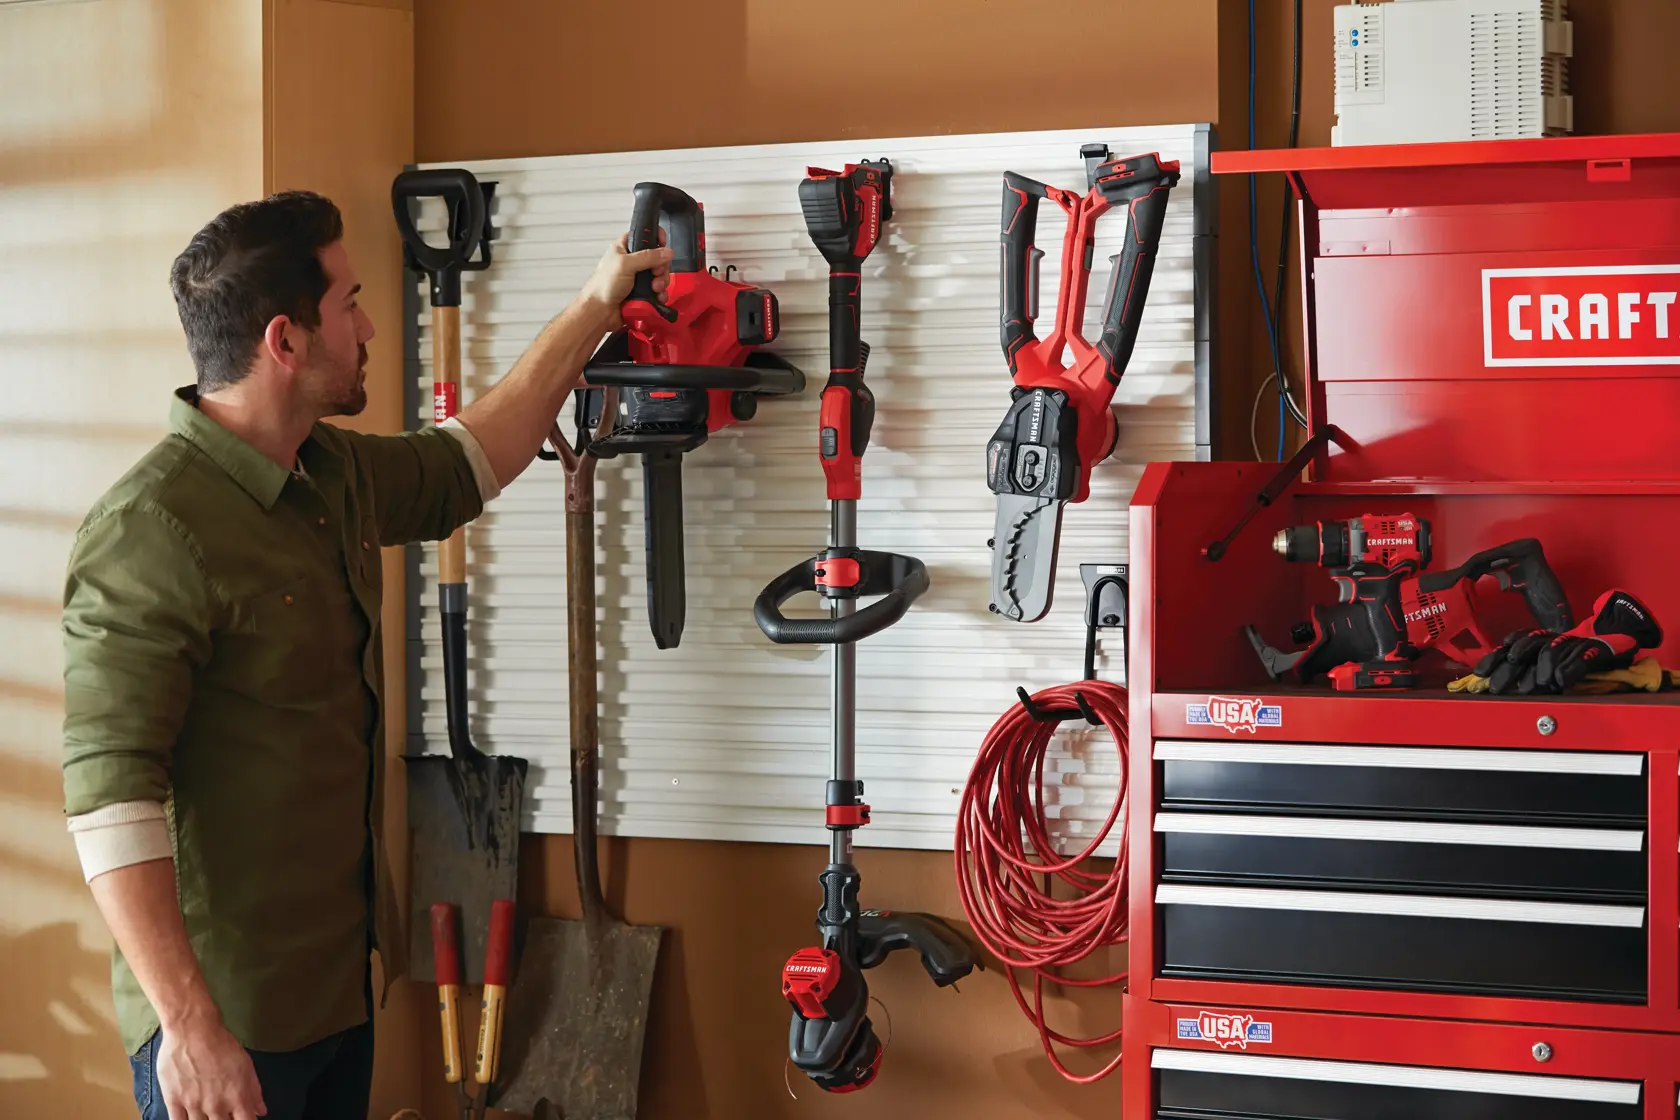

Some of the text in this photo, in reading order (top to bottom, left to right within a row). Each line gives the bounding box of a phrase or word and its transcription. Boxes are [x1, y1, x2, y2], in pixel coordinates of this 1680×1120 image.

[869, 195, 877, 244] CRAFTSMAN
[1508, 292, 1678, 341] CRAFT
[1029, 390, 1043, 442] CRAFTSMAN
[1367, 538, 1413, 546] CRAFTSMAN
[1404, 602, 1447, 624] FTSMAN
[1212, 702, 1255, 723] USA
[786, 965, 827, 973] CRAFTSMAN
[1203, 1017, 1245, 1039] USA
